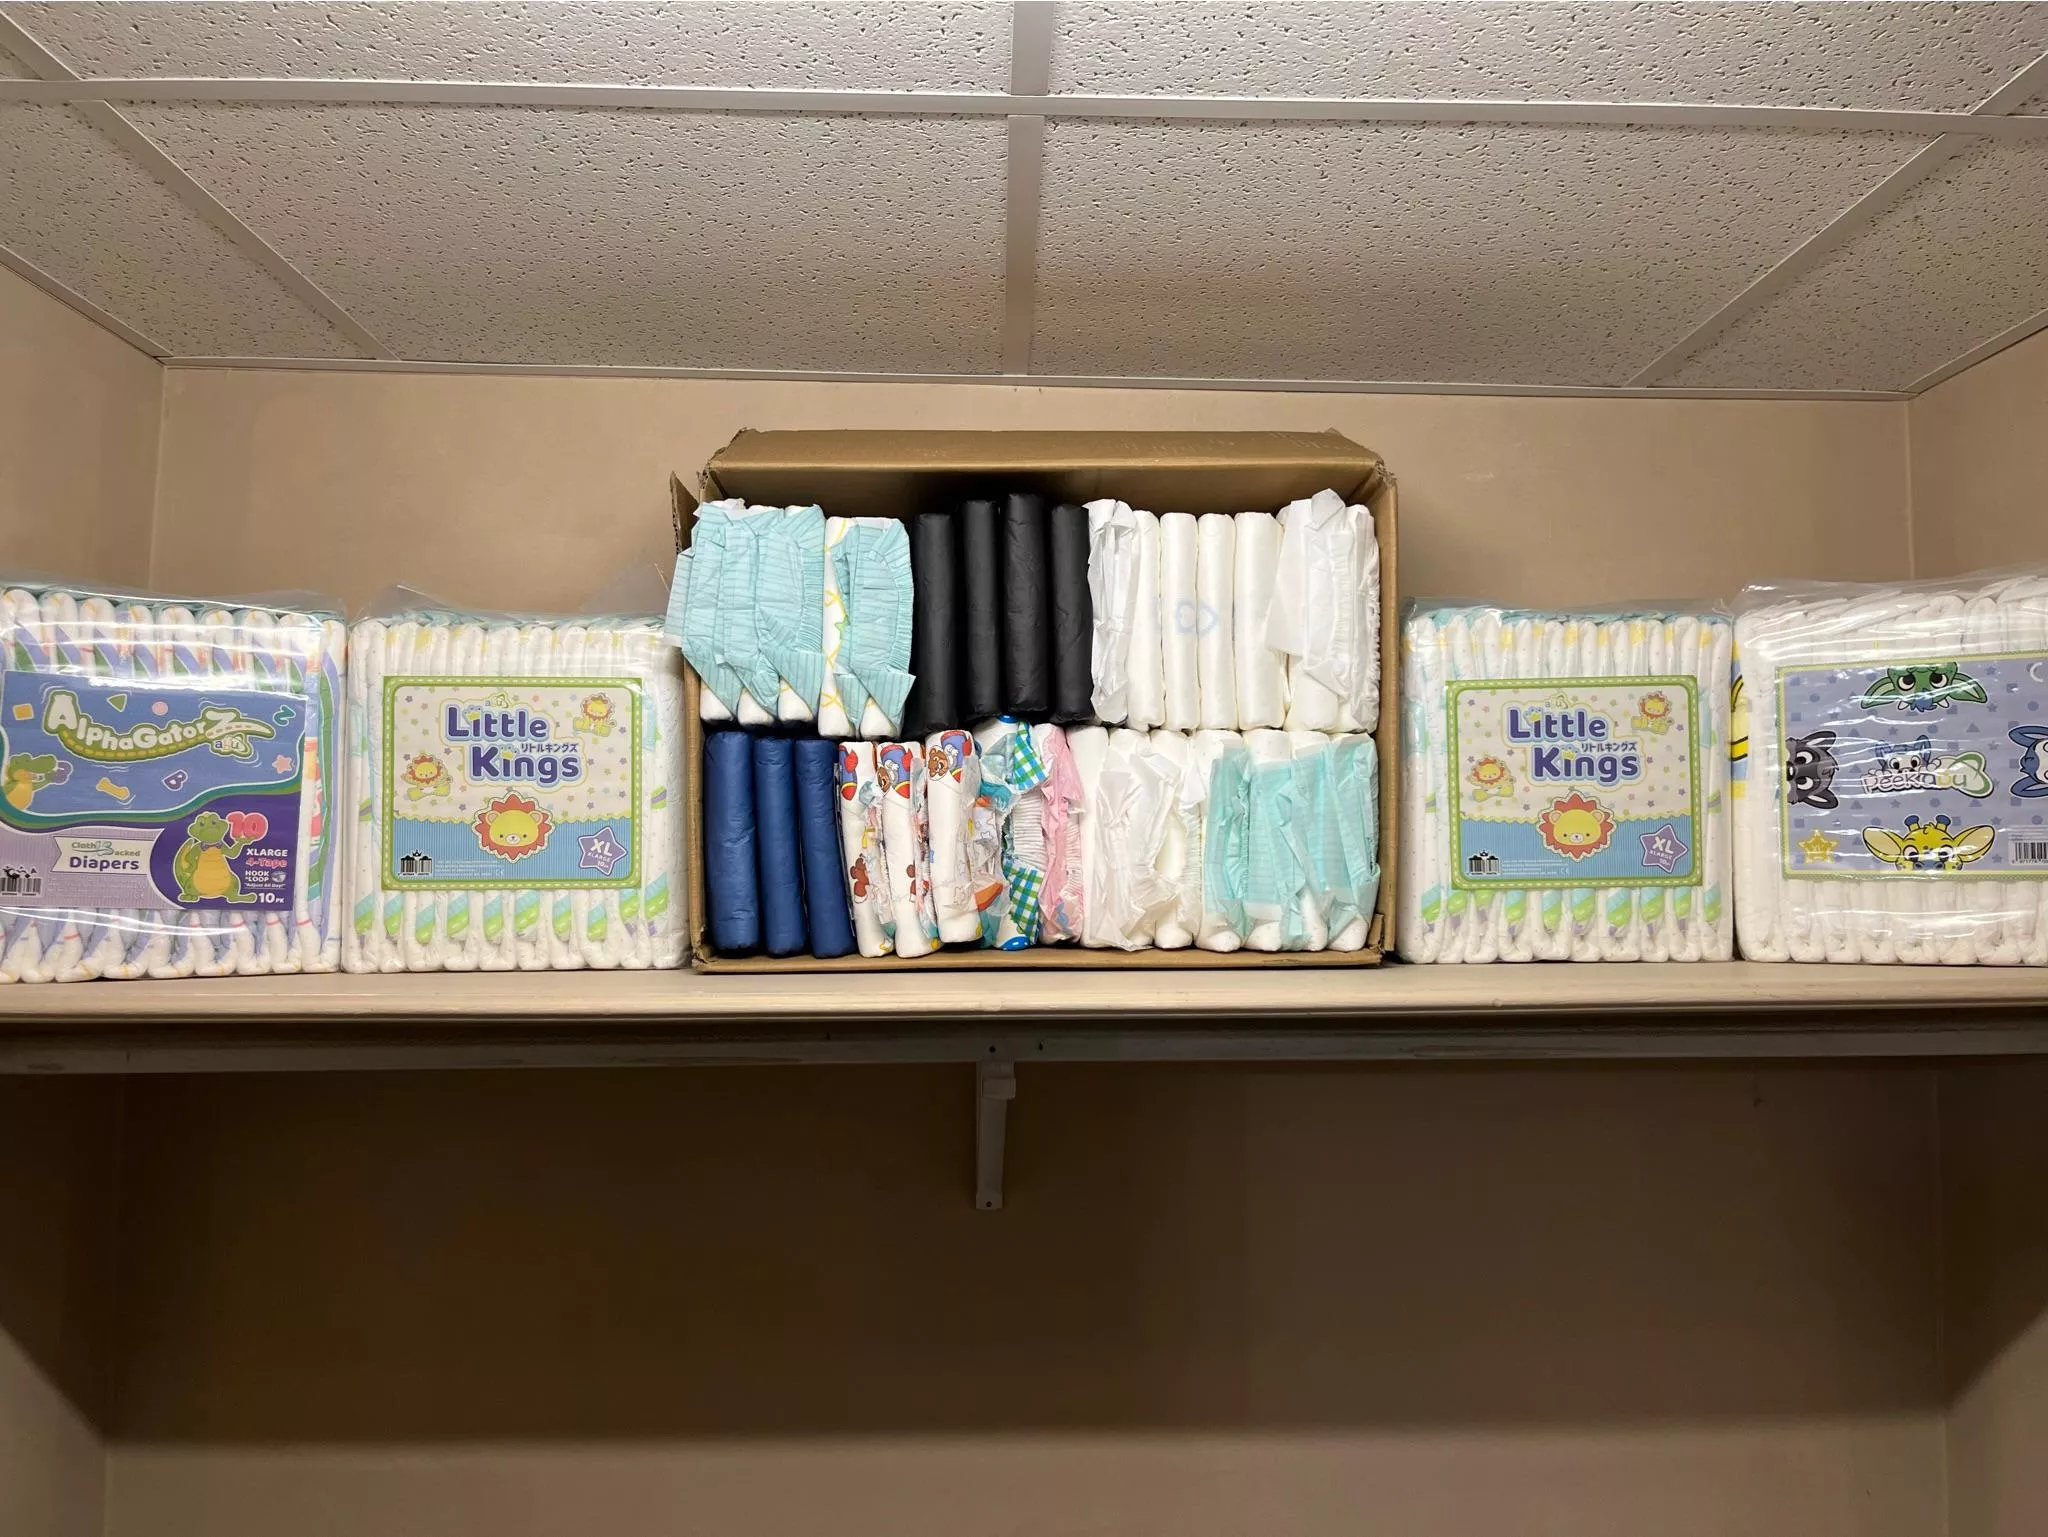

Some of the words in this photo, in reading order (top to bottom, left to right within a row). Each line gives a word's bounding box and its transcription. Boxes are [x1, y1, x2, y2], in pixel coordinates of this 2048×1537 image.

[448, 706, 548, 738] Little
[1509, 708, 1606, 739] Little
[472, 746, 579, 784] Kings
[1533, 747, 1638, 783] Kings
[71, 841, 97, 849] Cloth
[246, 848, 289, 857] XLARGE
[590, 838, 613, 857] XL
[1652, 836, 1674, 854] XL
[69, 856, 140, 872] Diapers
[245, 857, 288, 869] 4-Tape
